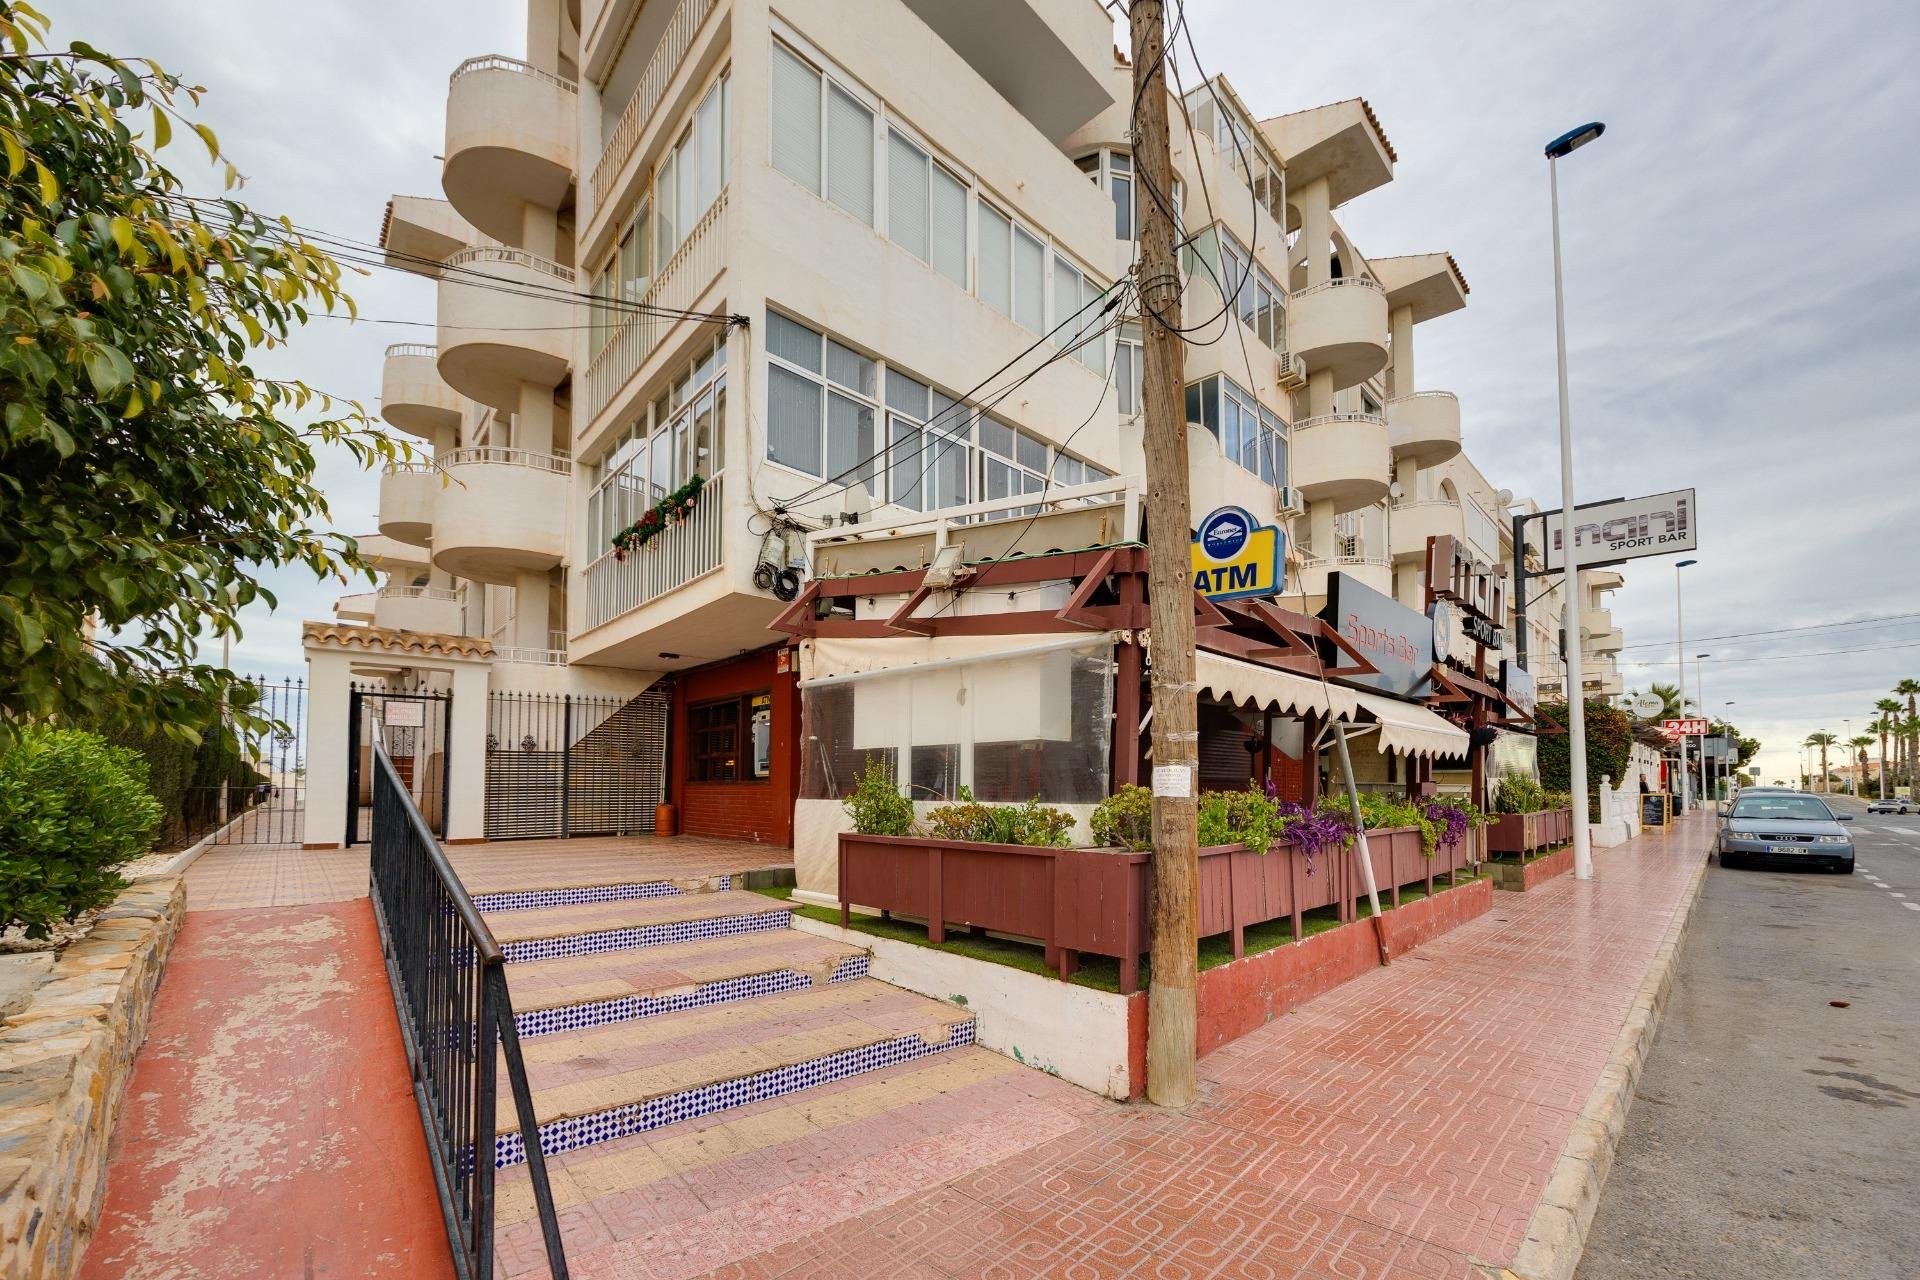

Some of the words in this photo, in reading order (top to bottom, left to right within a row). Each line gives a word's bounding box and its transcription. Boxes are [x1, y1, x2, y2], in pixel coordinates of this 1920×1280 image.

[1213, 527, 1237, 536] Euronet
[1610, 537, 1653, 551] SPORT
[1658, 531, 1687, 545] BAR
[1194, 563, 1257, 593] ATM
[1348, 613, 1395, 656] Sports
[1668, 721, 1706, 734] 24H
